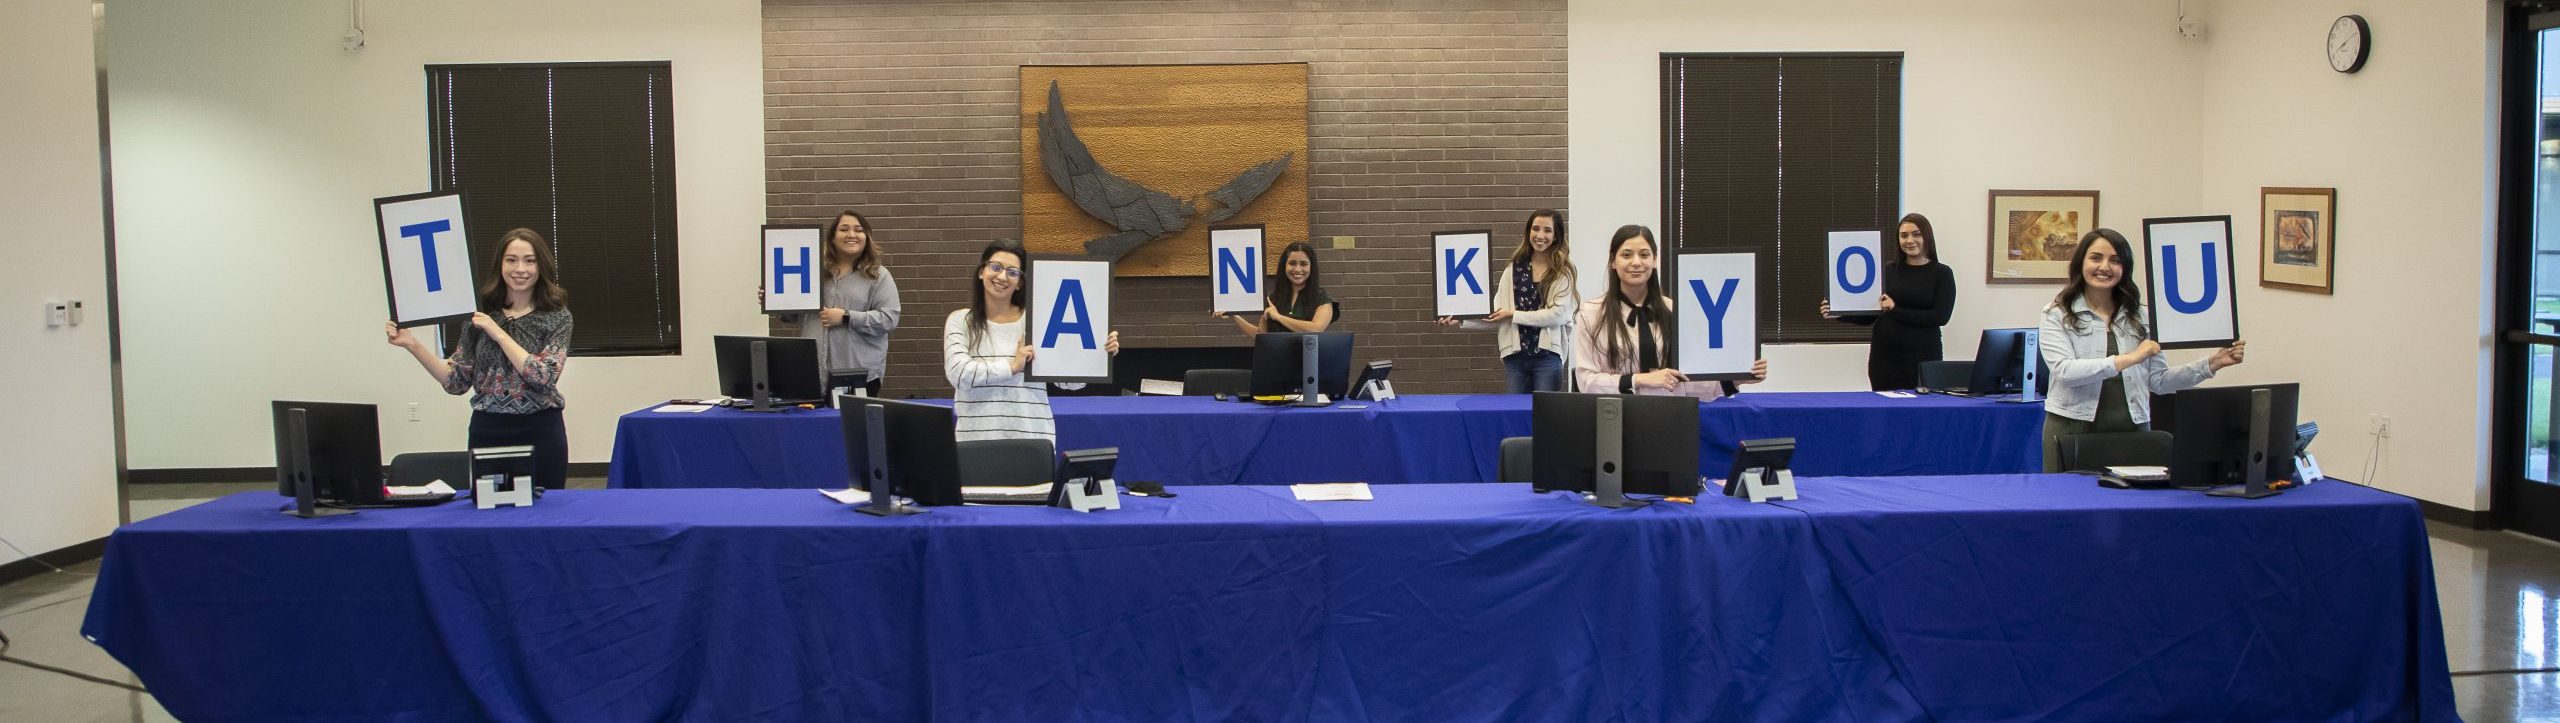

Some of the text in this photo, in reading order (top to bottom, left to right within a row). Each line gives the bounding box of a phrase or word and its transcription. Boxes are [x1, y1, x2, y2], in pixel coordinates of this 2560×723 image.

[400, 219, 450, 292] T
[774, 247, 810, 294] H
[1219, 247, 1256, 294] N
[1446, 248, 1482, 295] K
[1837, 246, 1875, 294] O
[2162, 242, 2218, 314] U
[1042, 279, 1096, 349] A
[1690, 278, 1739, 349] Y
